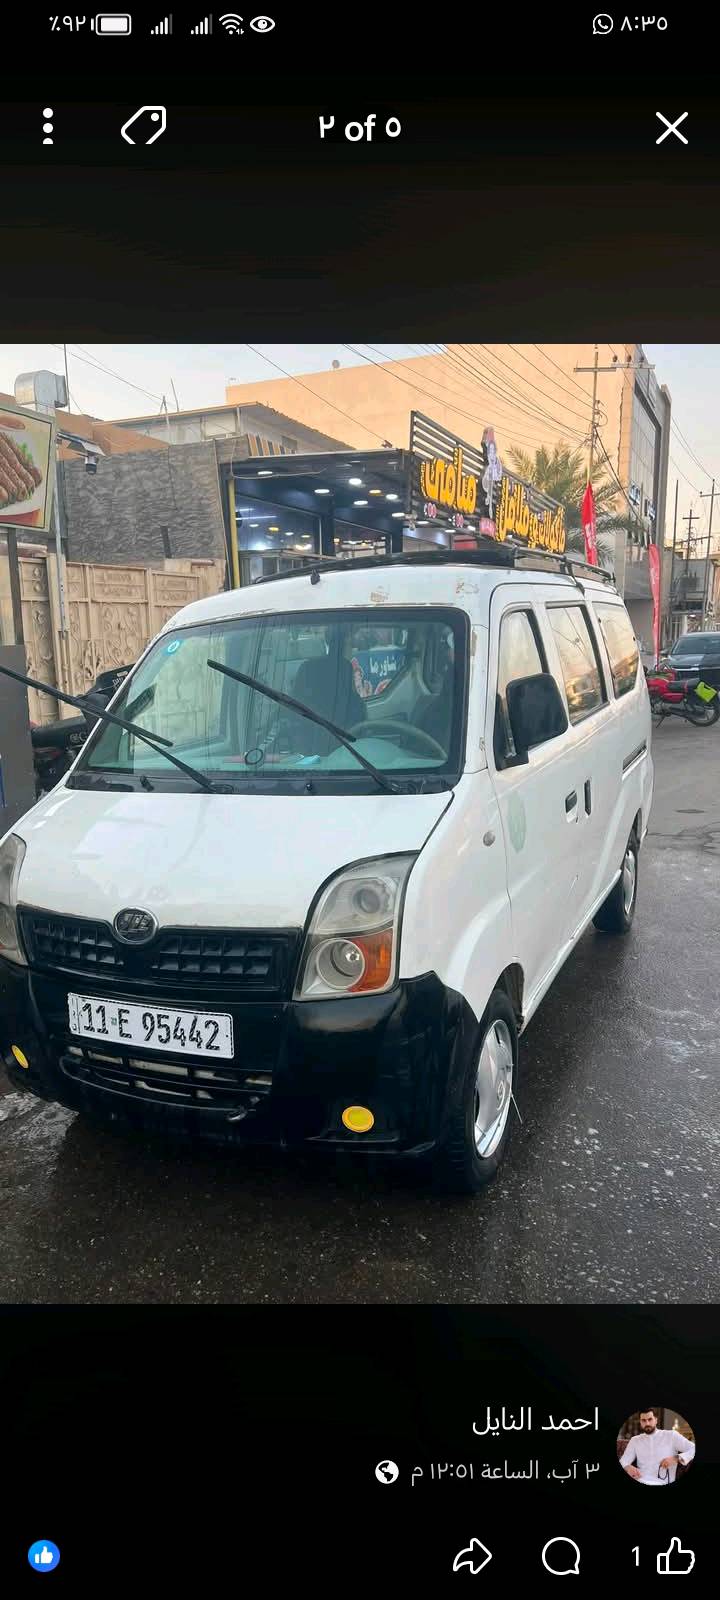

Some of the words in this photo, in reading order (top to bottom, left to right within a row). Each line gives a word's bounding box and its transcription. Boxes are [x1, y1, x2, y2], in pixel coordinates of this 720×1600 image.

[80, 1002, 109, 1035] 11
[117, 1008, 133, 1039] E
[142, 1011, 221, 1052] 95442
